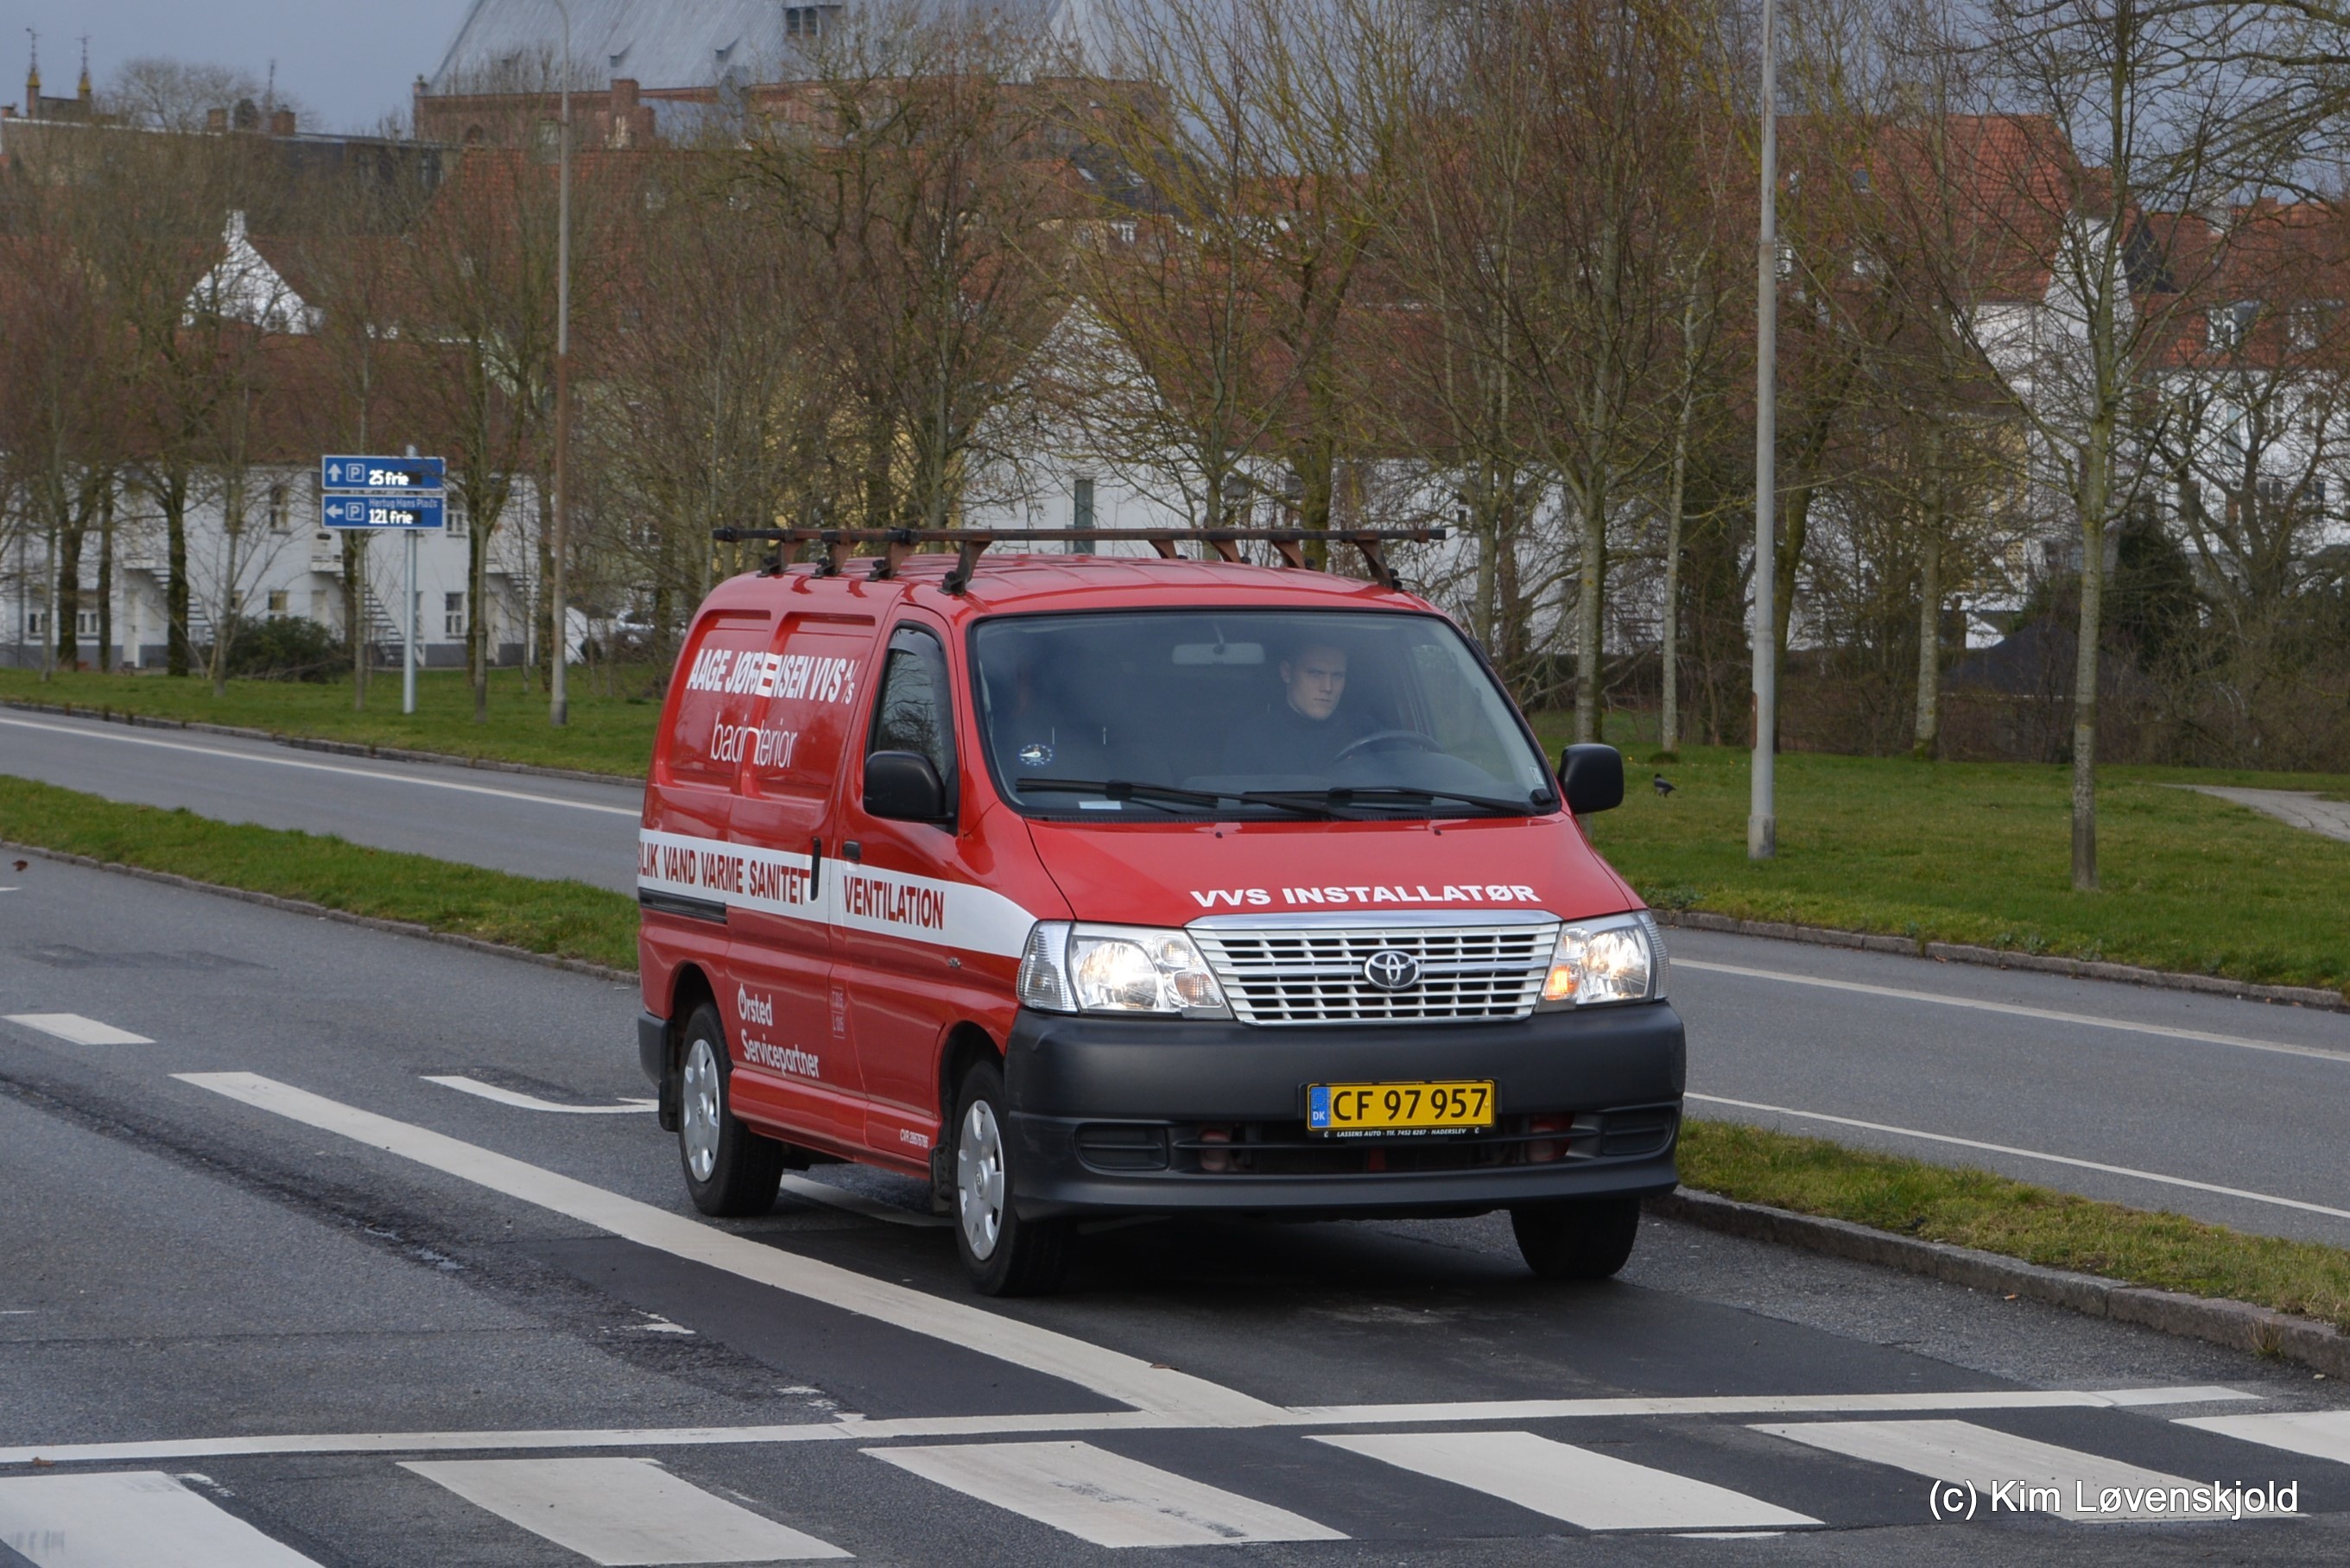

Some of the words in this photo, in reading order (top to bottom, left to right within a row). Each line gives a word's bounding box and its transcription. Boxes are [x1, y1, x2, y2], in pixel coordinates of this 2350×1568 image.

[369, 470, 384, 485] 25
[385, 471, 409, 485] frie
[369, 509, 389, 524] 121
[390, 510, 414, 524] frie
[687, 648, 732, 692] AAGE
[809, 656, 846, 704] VVS
[663, 845, 696, 885] VAND
[701, 851, 744, 894] VARME
[749, 860, 810, 906] SANITET
[843, 875, 945, 931] VENTILATION
[1189, 888, 1271, 907] VVS
[1282, 885, 1542, 904] INSTALLATØR
[738, 983, 774, 1027] Ørsted
[740, 1028, 820, 1078] Servicepartner
[1312, 1110, 1326, 1121] DK
[1333, 1091, 1374, 1121] CF
[1384, 1090, 1422, 1121] 97
[1430, 1088, 1488, 1120] 957
